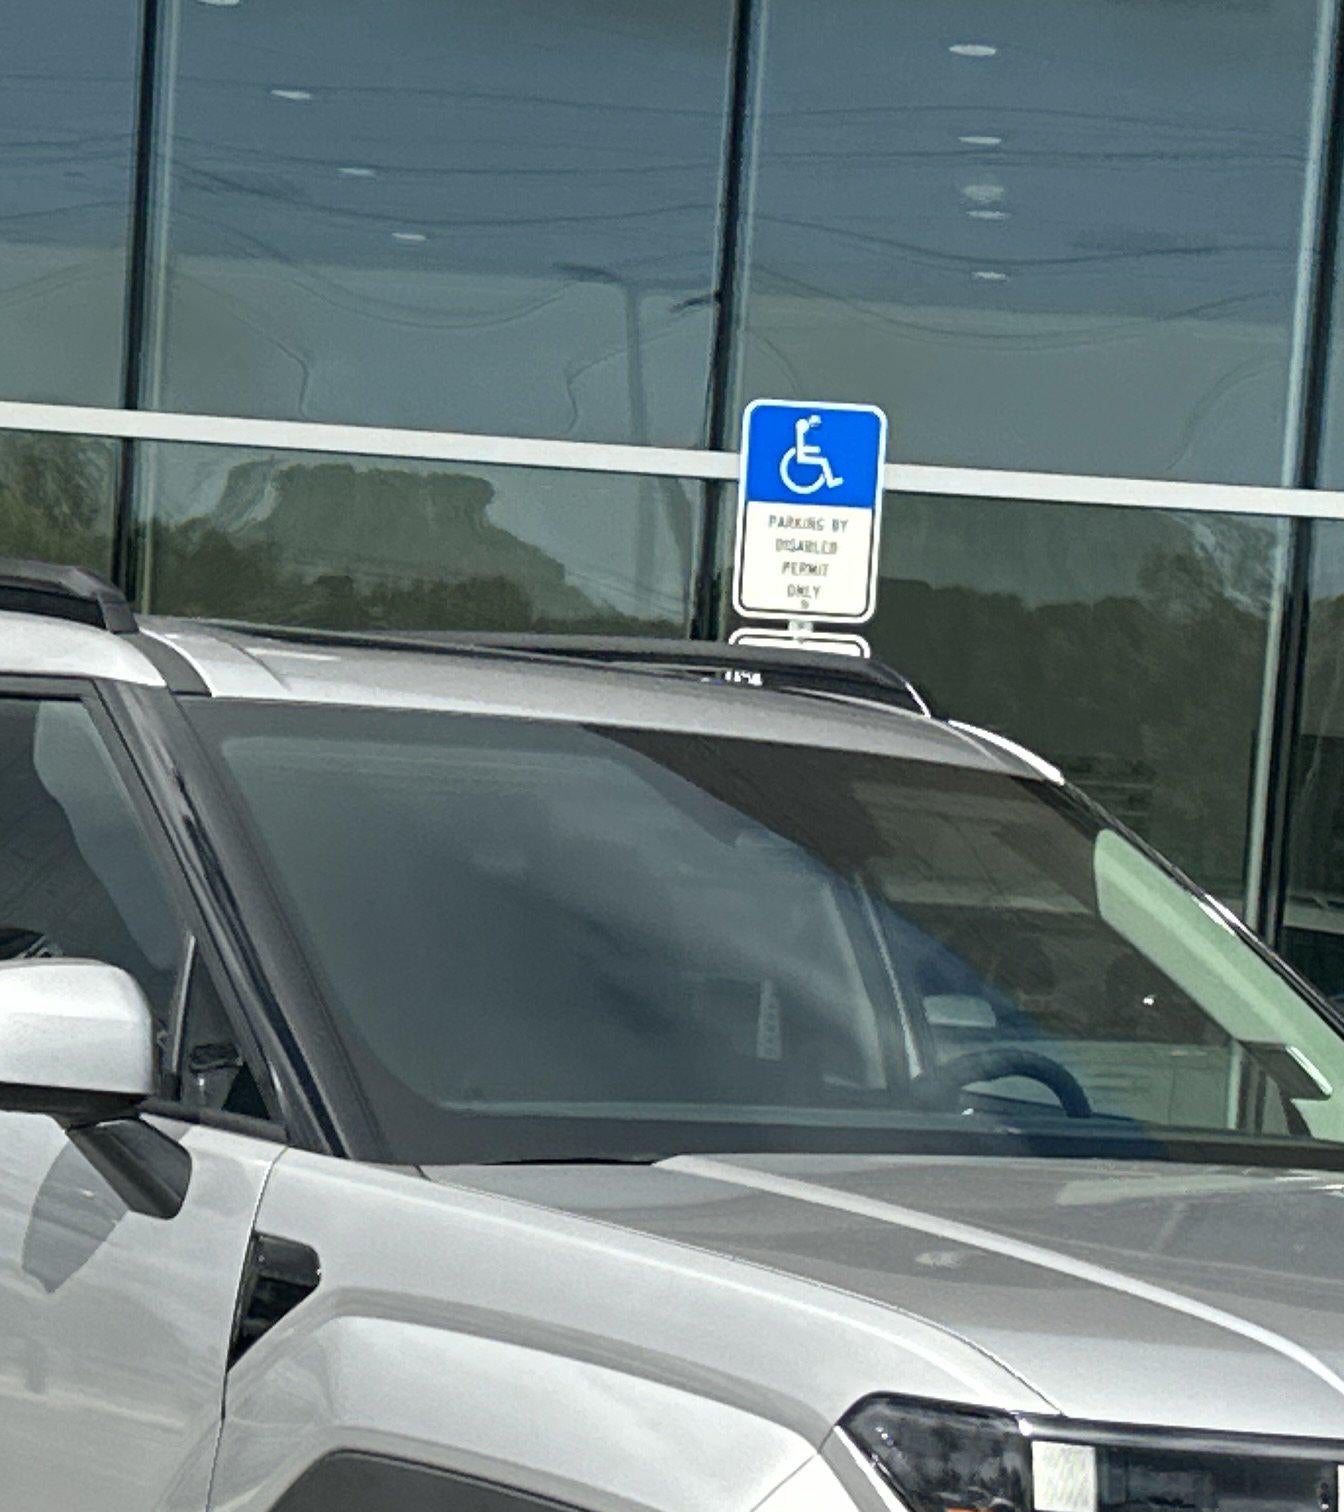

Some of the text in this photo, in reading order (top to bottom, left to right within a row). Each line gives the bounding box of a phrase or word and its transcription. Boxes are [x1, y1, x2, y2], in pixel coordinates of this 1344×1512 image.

[768, 514, 848, 532] PARKING BY
[775, 538, 838, 554] DISABLED
[782, 561, 829, 576] PERMIT
[787, 584, 821, 598] ONLY
